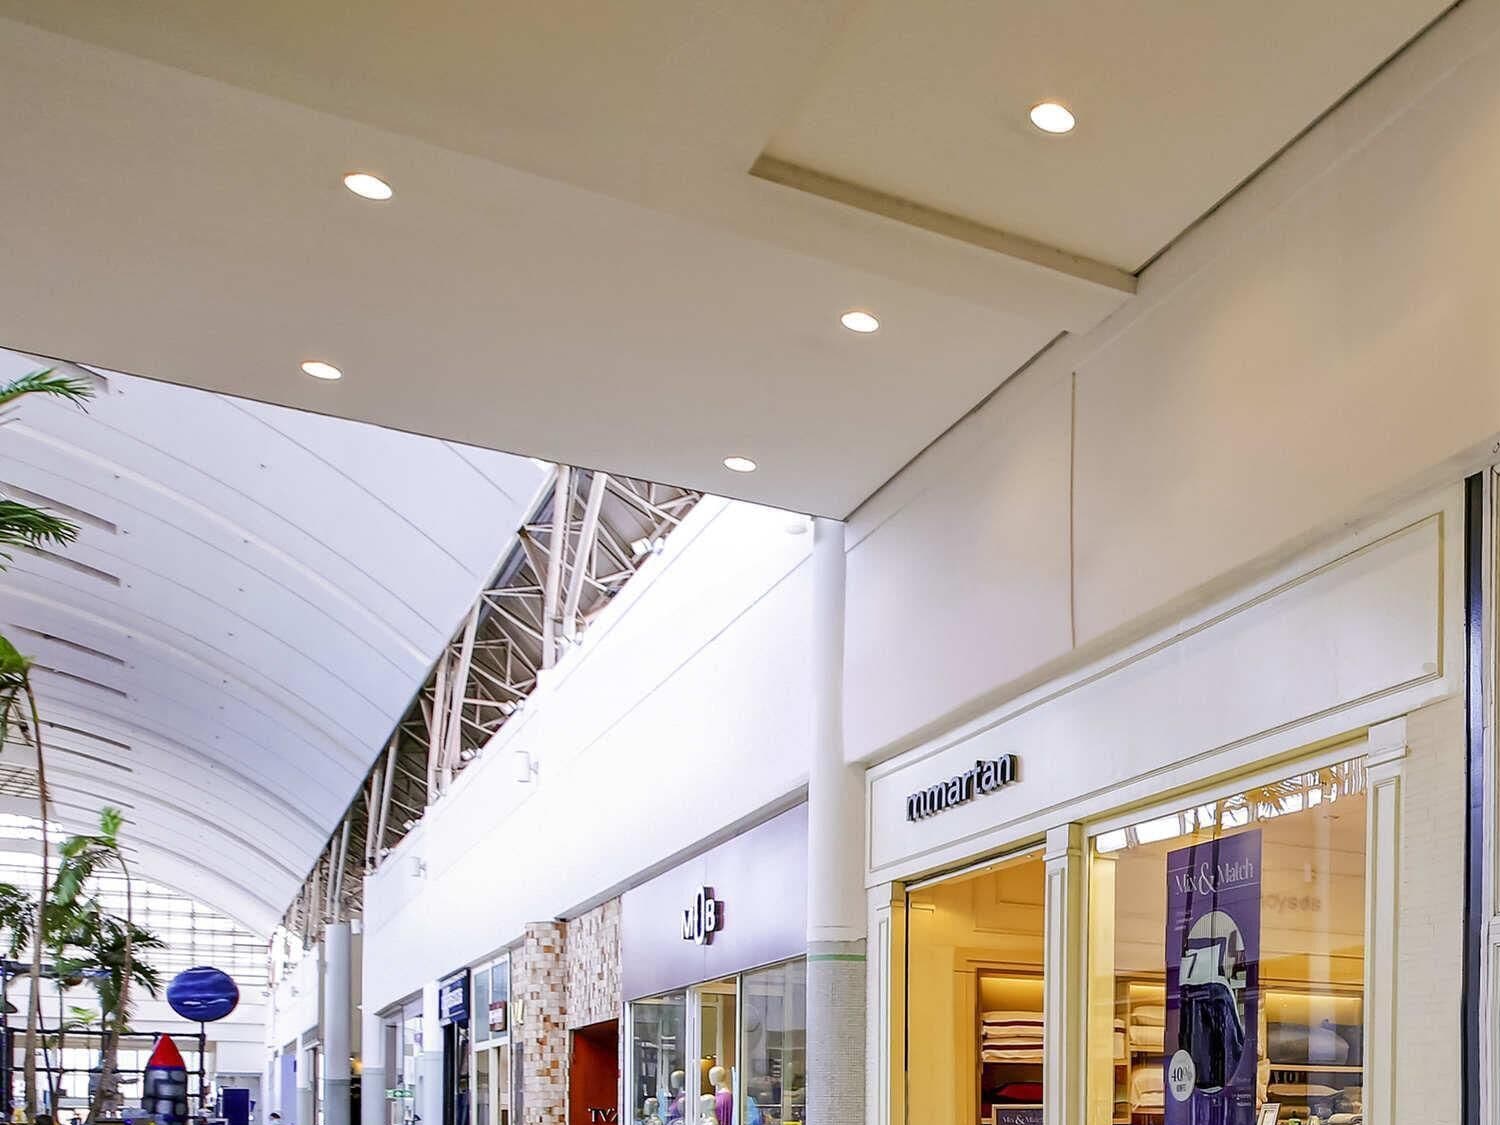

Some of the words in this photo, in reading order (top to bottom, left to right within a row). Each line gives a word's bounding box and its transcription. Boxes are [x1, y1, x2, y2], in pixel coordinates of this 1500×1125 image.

[905, 753, 1017, 823] mmartan
[1175, 873, 1198, 895] Mix
[1198, 862, 1217, 896] &
[1217, 856, 1255, 886] Match
[680, 884, 723, 946] MOB
